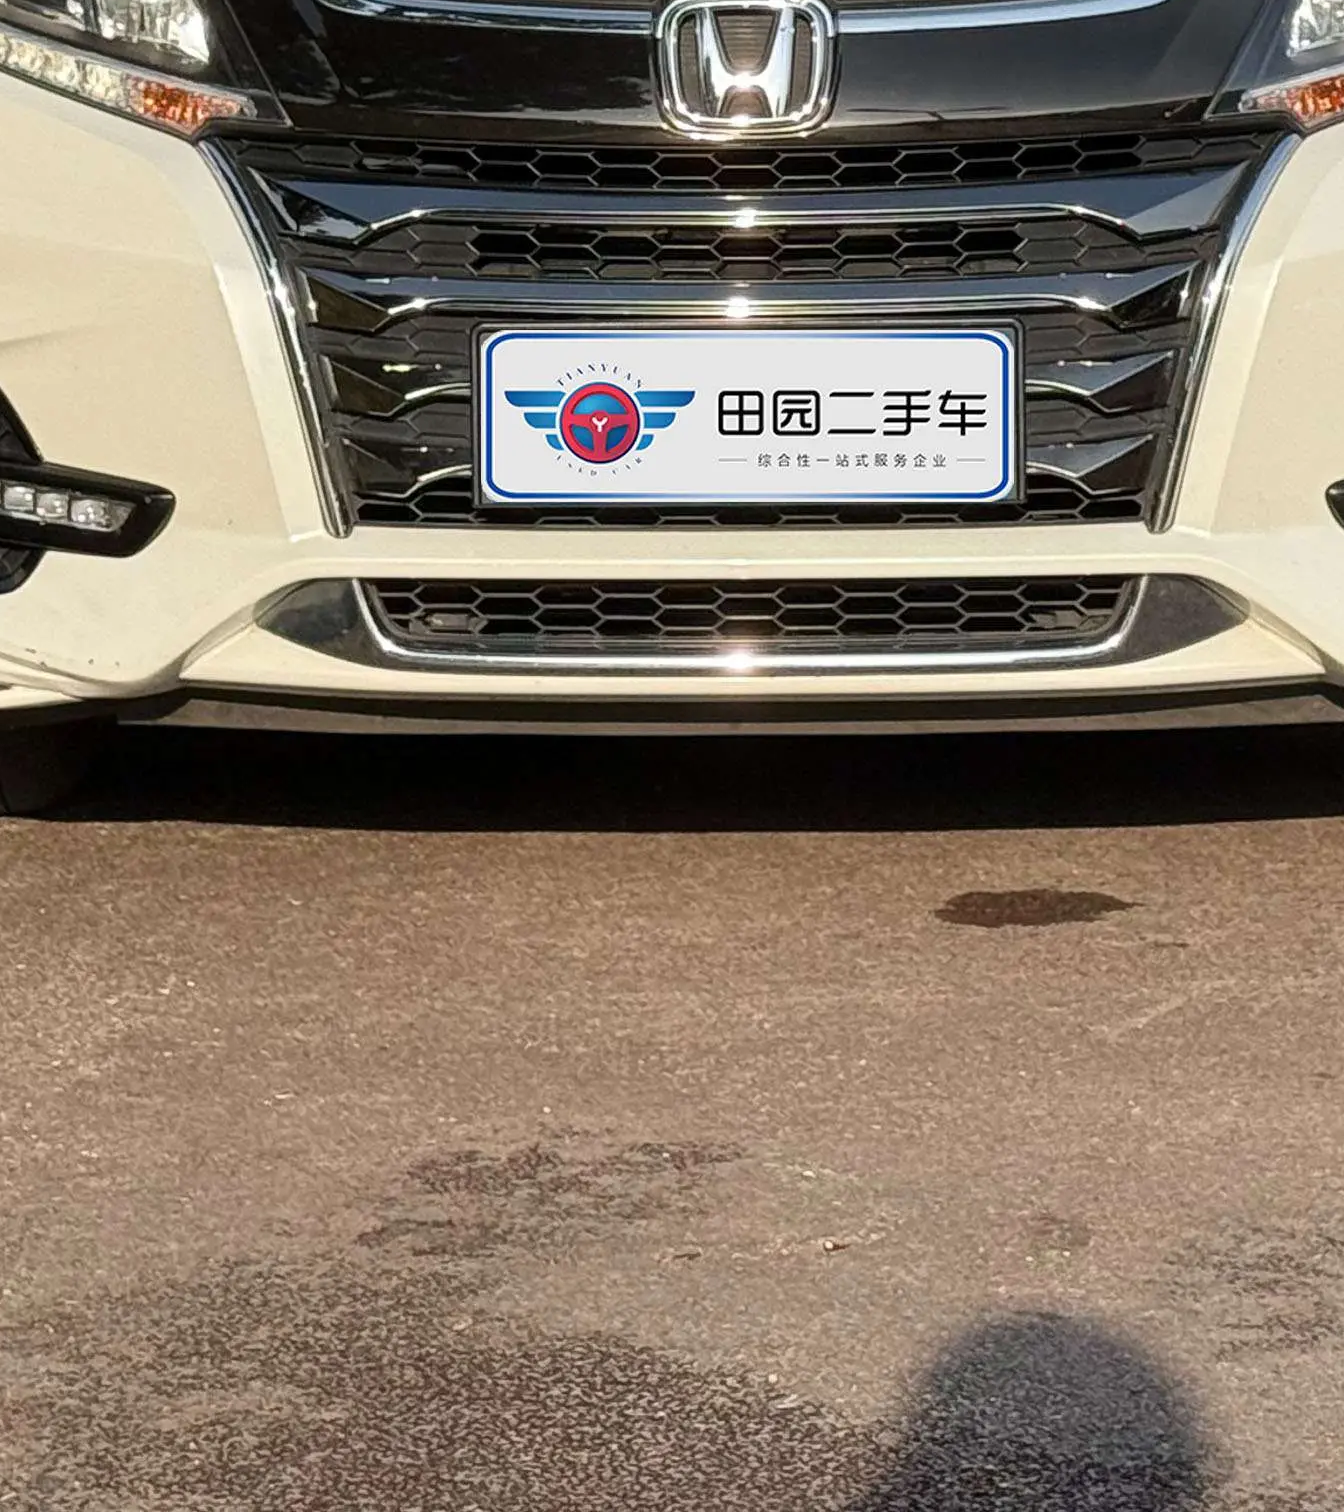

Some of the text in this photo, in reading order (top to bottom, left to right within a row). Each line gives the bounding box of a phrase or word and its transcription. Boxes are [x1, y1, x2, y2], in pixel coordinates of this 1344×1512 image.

[718, 389, 988, 437] 田园二手车
[757, 452, 947, 469] 综合性一站式服务企业
